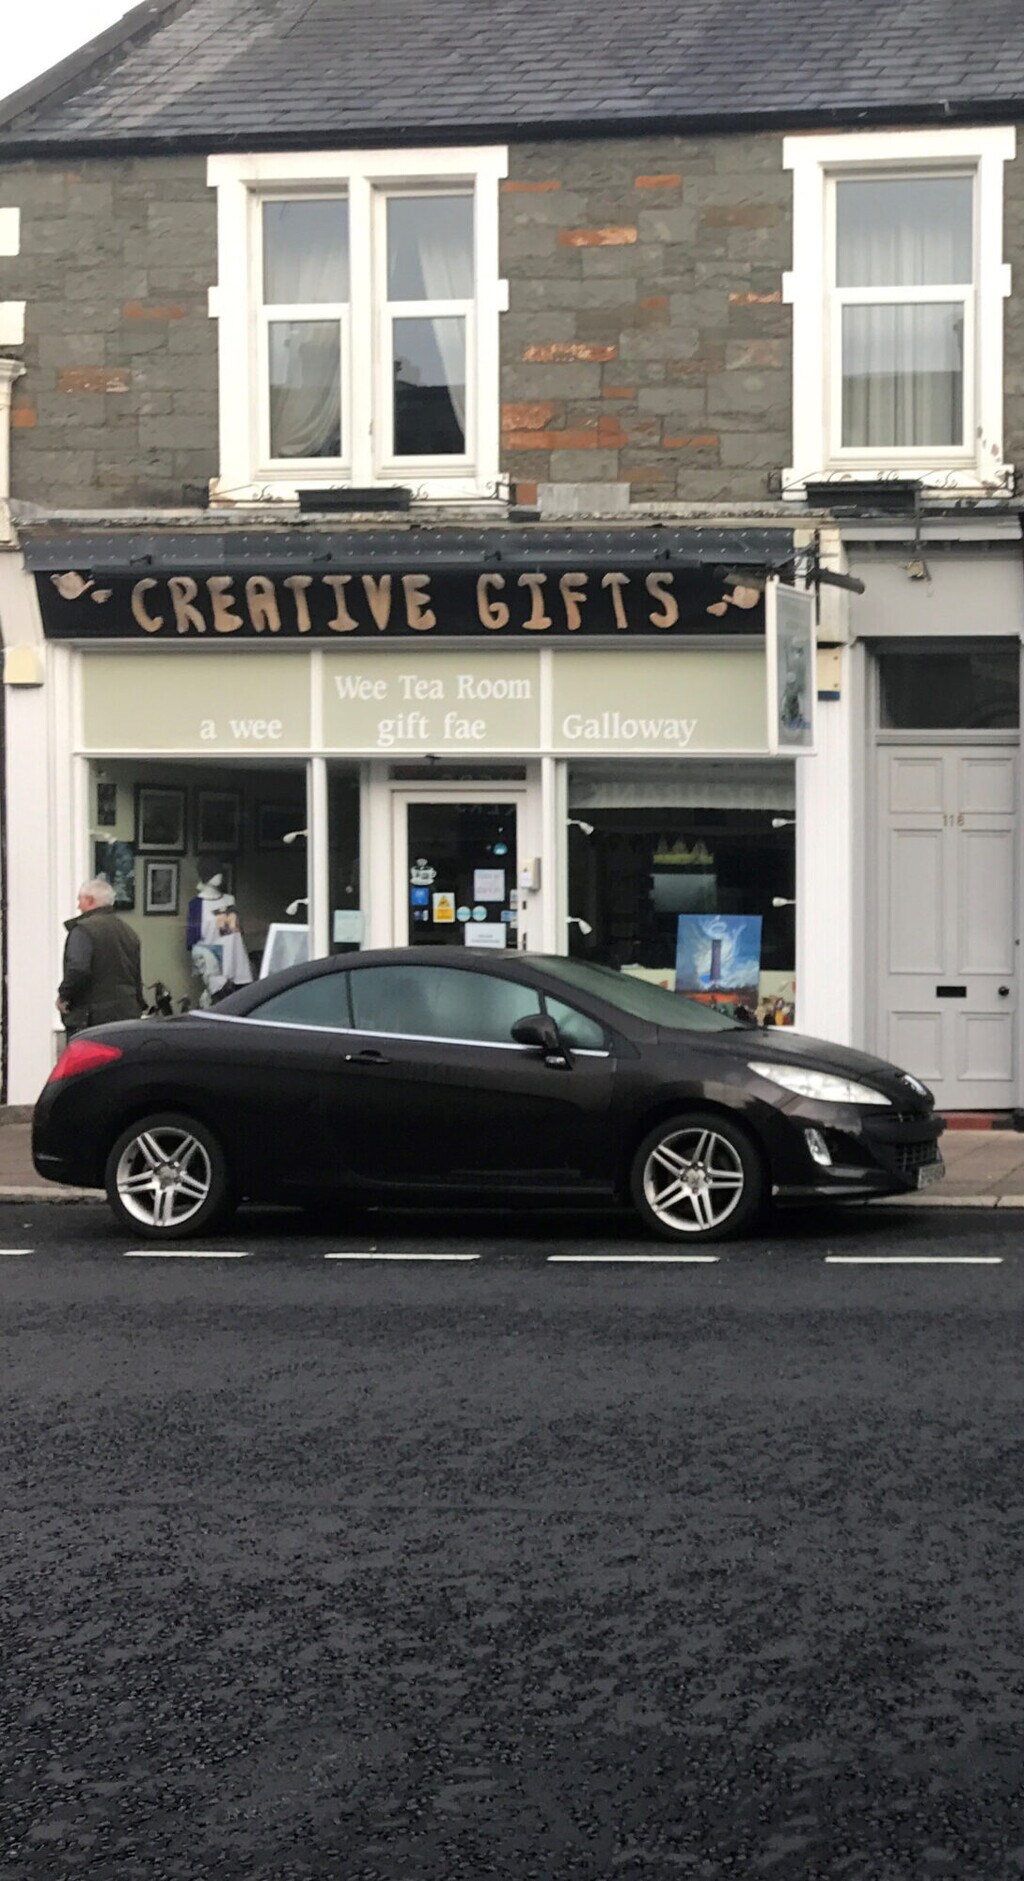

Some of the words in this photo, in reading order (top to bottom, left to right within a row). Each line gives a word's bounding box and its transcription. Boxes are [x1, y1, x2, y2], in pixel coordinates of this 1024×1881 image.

[131, 574, 436, 633] CREATIVE
[477, 572, 679, 631] GIFTS
[335, 675, 387, 700] Wee
[399, 675, 444, 700] Tea
[457, 675, 532, 700] Room
[200, 719, 216, 740] a
[229, 719, 283, 739] wee
[376, 711, 429, 747] gift
[443, 712, 487, 740] fae
[562, 713, 698, 746] Galloway
